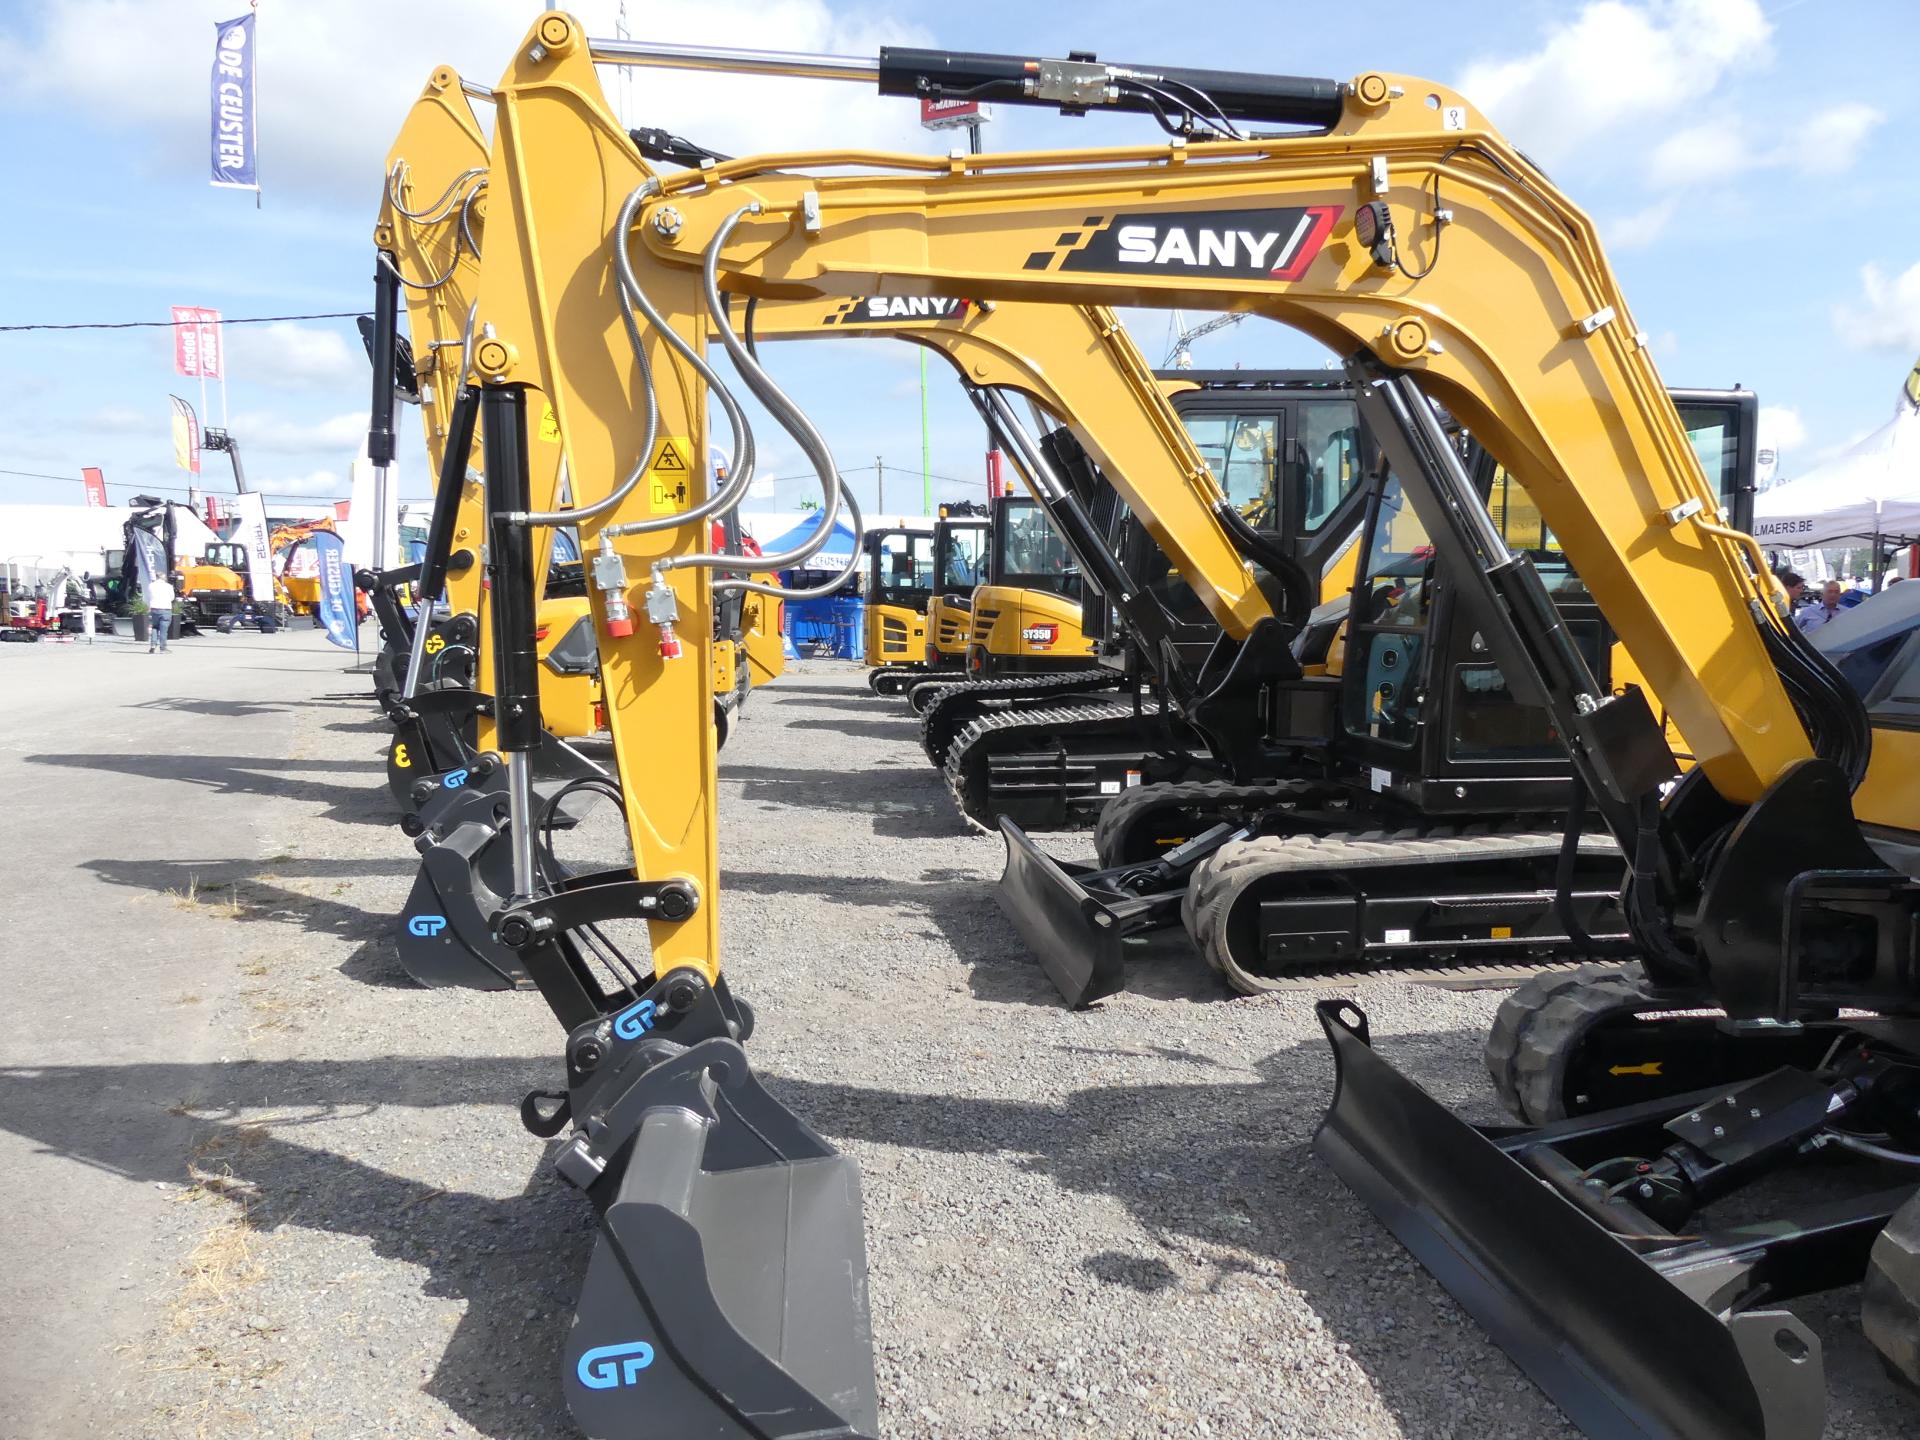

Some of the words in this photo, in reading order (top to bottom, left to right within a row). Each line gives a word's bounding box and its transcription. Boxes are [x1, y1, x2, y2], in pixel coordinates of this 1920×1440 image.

[218, 51, 243, 78] DE
[219, 83, 244, 169] CEUSTER
[1118, 225, 1280, 268] SANY
[867, 296, 948, 317] SANY
[1754, 520, 1813, 536] LMAERS.BE
[444, 769, 468, 788] GP
[409, 915, 447, 936] GP
[615, 999, 657, 1040] GP
[577, 1341, 655, 1390] GP
